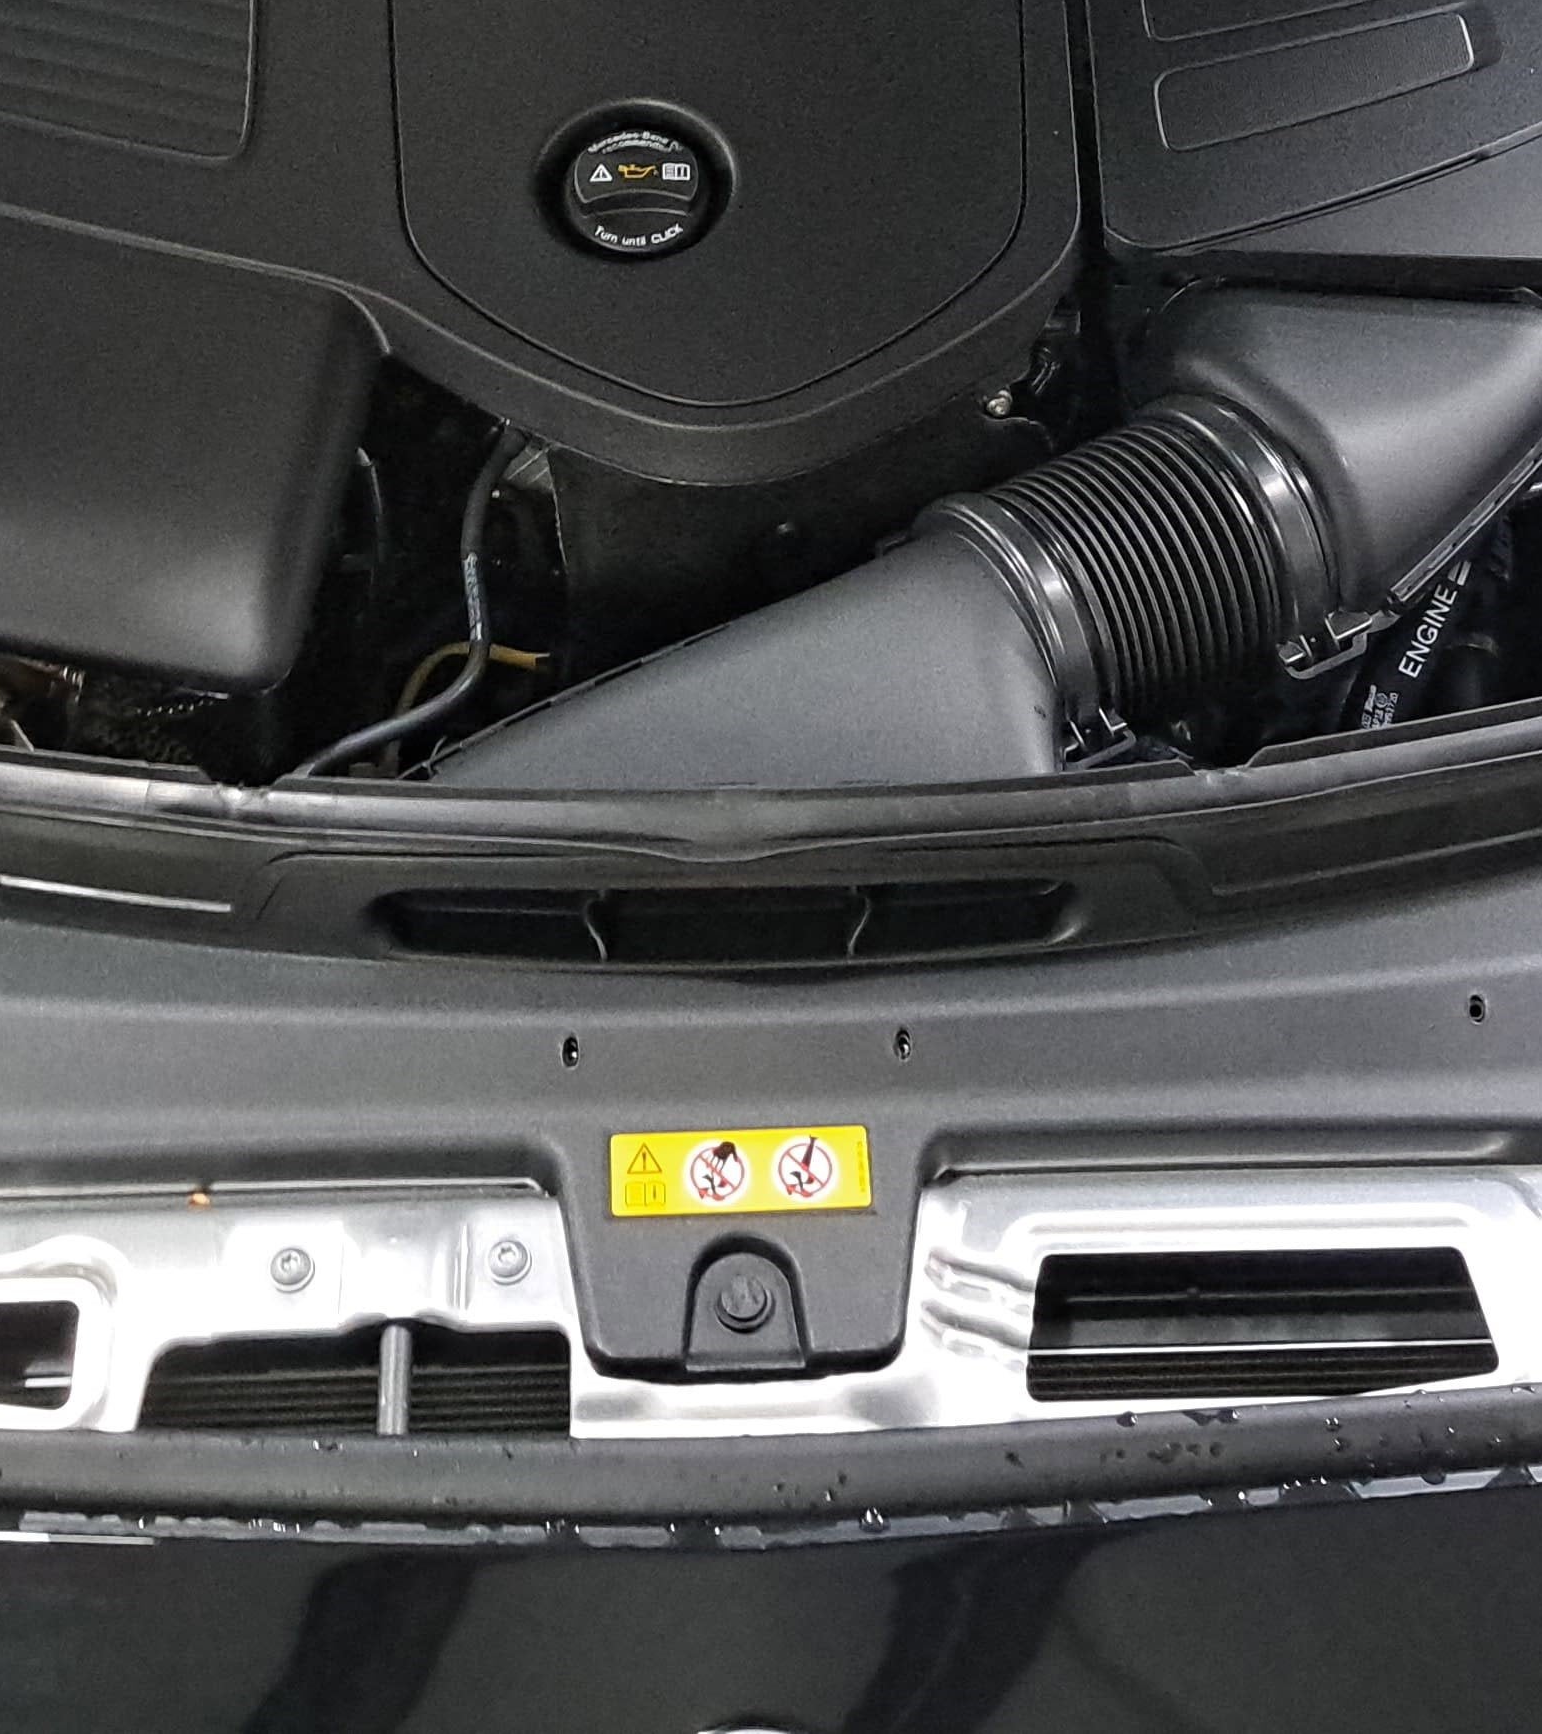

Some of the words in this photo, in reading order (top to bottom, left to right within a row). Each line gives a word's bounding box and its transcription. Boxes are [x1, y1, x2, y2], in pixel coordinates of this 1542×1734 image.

[594, 225, 618, 243] Turn
[621, 235, 647, 246] until
[650, 223, 684, 244] CLICK
[1398, 584, 1458, 678] ENGINE
